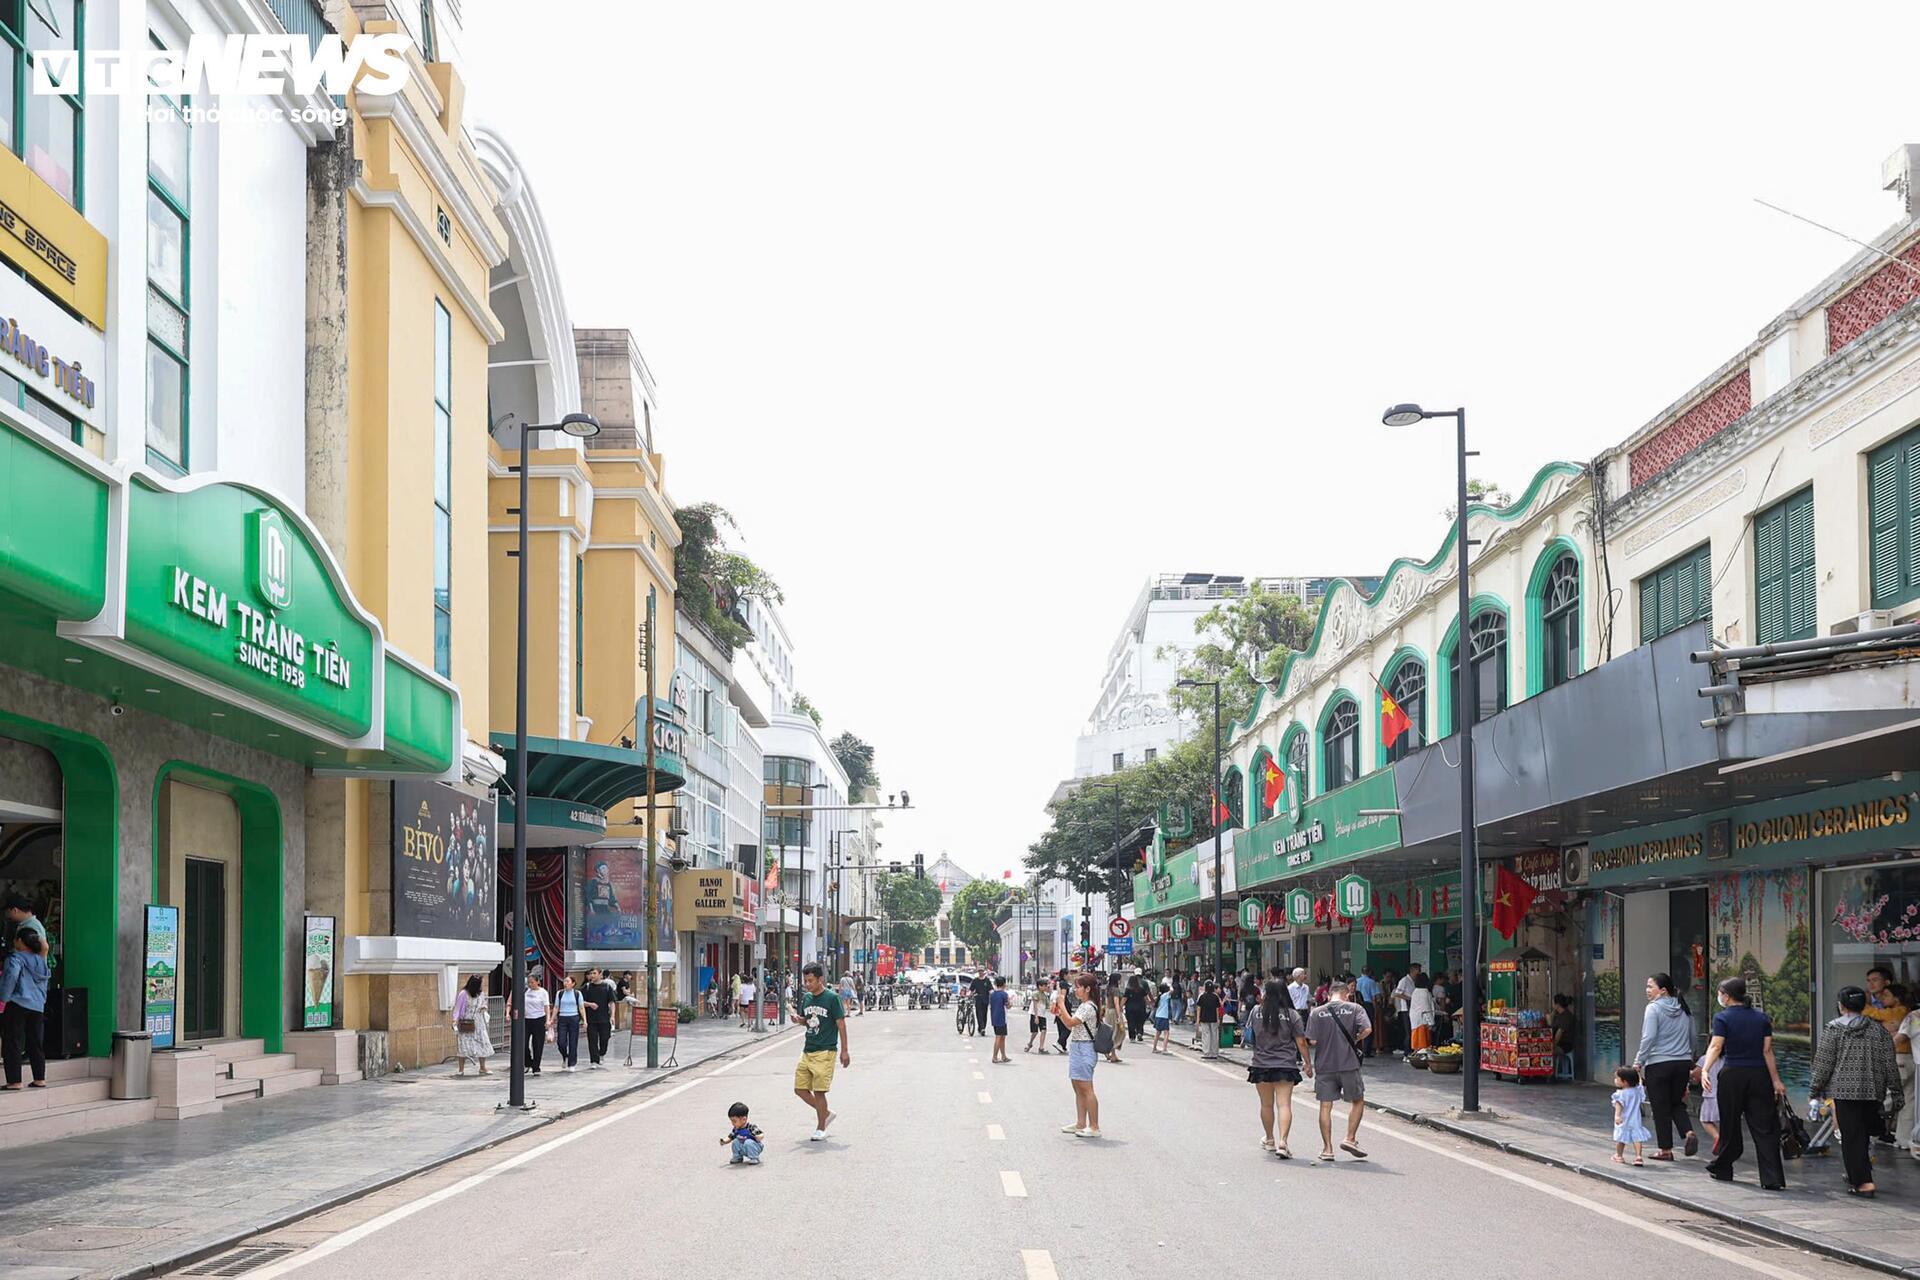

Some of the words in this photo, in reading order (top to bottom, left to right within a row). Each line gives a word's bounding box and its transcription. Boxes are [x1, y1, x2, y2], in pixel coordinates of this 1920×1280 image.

[25, 228, 77, 281] SPACE
[174, 566, 228, 628] KEM
[237, 600, 305, 665] TRÀNG
[313, 640, 351, 688] TIỀN
[239, 642, 278, 677] SINCE
[281, 661, 305, 688] 1958
[1736, 823, 1758, 848] HO
[1759, 815, 1808, 845] GUOM
[1811, 795, 1909, 837] CERAMICS
[1640, 832, 1703, 864] CERAMICS
[699, 878, 722, 887] HANOI
[704, 889, 718, 897] ART
[695, 899, 726, 908] GALLERY
